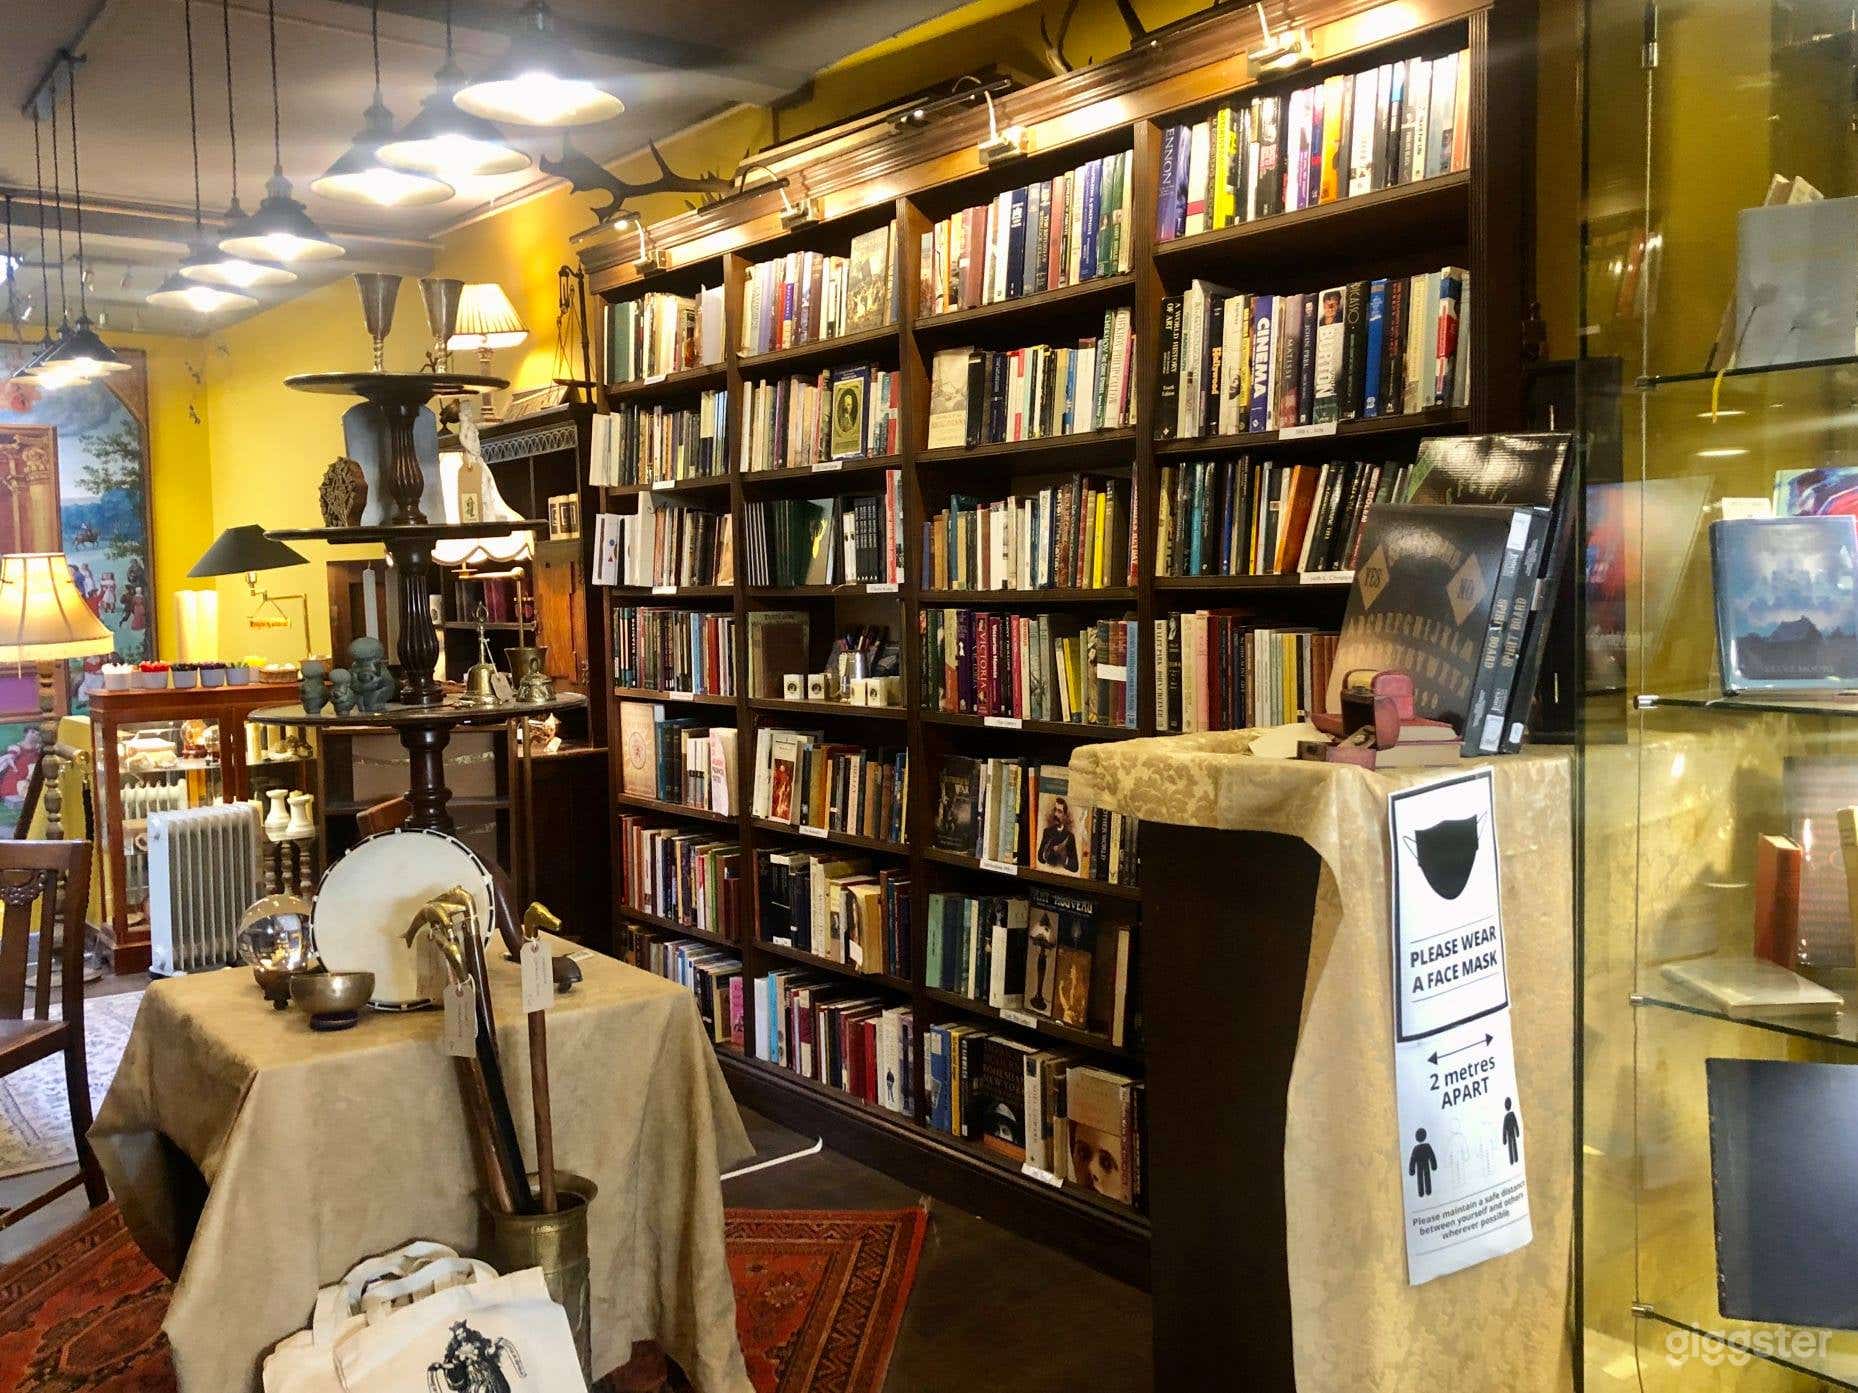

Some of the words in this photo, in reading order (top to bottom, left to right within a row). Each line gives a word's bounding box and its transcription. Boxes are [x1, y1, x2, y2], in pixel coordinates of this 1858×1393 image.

[1164, 315, 1173, 331] ART
[1166, 302, 1174, 313] OF
[1172, 310, 1181, 337] WORLD
[1170, 337, 1180, 373] HISTORY
[1211, 346, 1222, 395] Hollywood
[1253, 316, 1271, 400] CINEMA
[1285, 338, 1295, 378] MATISSE
[1316, 328, 1336, 399] BURTON
[1511, 596, 1527, 631] BOARD
[978, 631, 987, 690] VICTORIA
[1483, 635, 1501, 669] BOARD
[1410, 938, 1458, 969] PLEASE
[1461, 925, 1497, 949] WEAR
[1412, 975, 1424, 993] A
[1427, 963, 1459, 989] FACE
[1461, 950, 1498, 977] MASK
[1429, 1072, 1440, 1091] 2
[1444, 1054, 1497, 1088] metres
[1441, 1076, 1490, 1110] APART
[1412, 1213, 1440, 1227] Please
[1442, 1201, 1477, 1219] maintain
[1484, 1192, 1500, 1204] safe
[1419, 1219, 1456, 1236] between
[1456, 1206, 1488, 1225] yourself
[1488, 1202, 1503, 1214] and
[1503, 1192, 1524, 1207] others
[1441, 1221, 1479, 1241] wherever
[1480, 1209, 1511, 1228] possible
